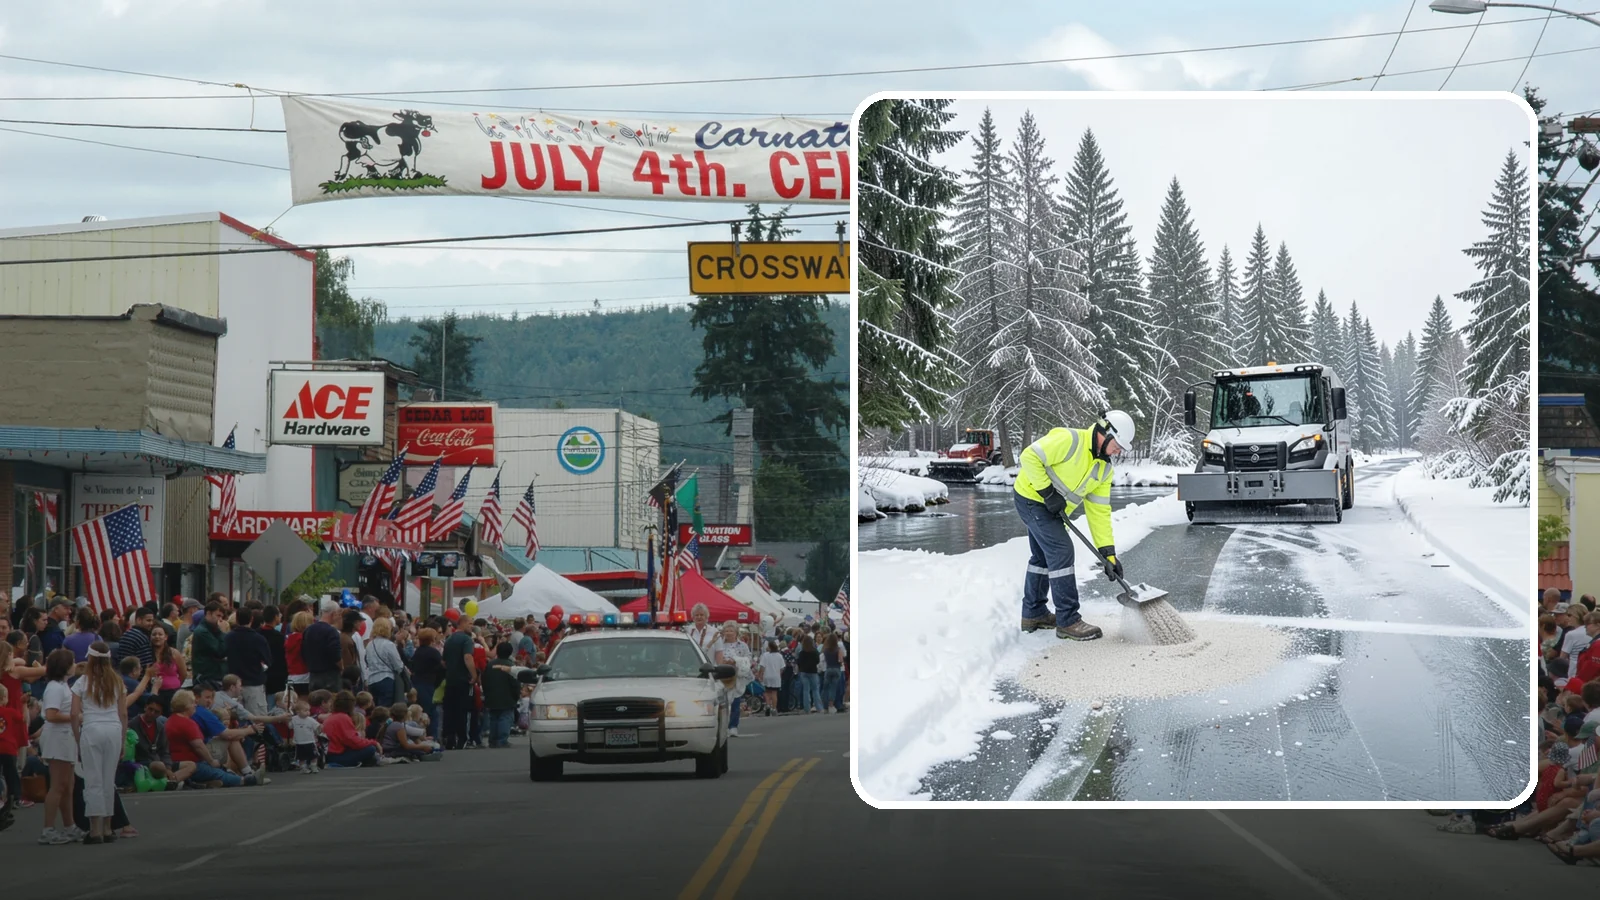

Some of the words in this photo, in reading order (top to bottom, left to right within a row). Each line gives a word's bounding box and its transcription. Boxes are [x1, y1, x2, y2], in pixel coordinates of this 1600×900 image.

[481, 140, 605, 192] JULY
[632, 150, 746, 198] 4th.
[696, 253, 850, 280] CROSSWA
[282, 380, 374, 420] ACE
[406, 409, 452, 422] CEDAR
[461, 409, 485, 421] LOG
[283, 421, 371, 436] Hardware
[416, 428, 477, 447] Coca-Cola
[95, 485, 124, 495] Vincent
[125, 486, 136, 495] de
[137, 486, 155, 495] Paul
[688, 526, 741, 535] CRNATION
[699, 535, 730, 543] GLASS
